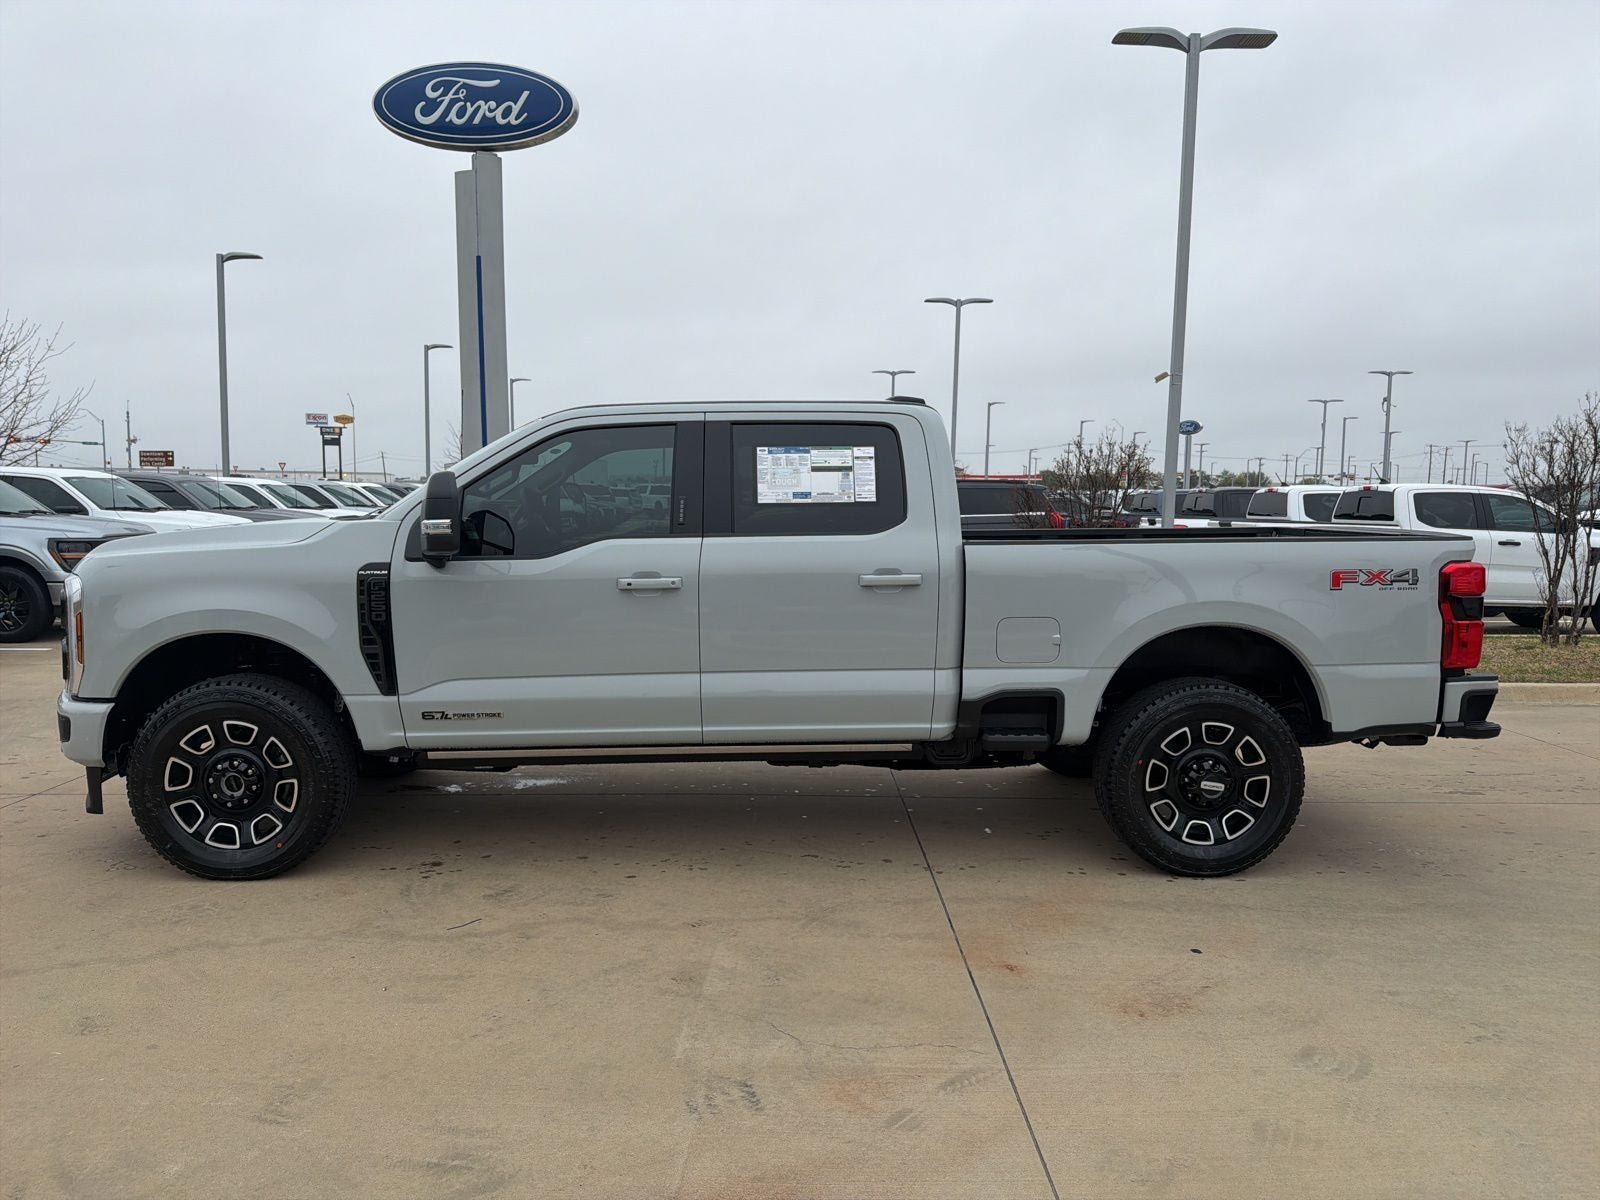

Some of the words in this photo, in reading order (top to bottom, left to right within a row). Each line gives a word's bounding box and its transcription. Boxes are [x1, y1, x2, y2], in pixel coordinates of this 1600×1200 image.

[414, 76, 530, 126] Ford
[307, 414, 327, 422] Exxon
[1329, 568, 1420, 591] FX4
[421, 711, 452, 720] 6.7L
